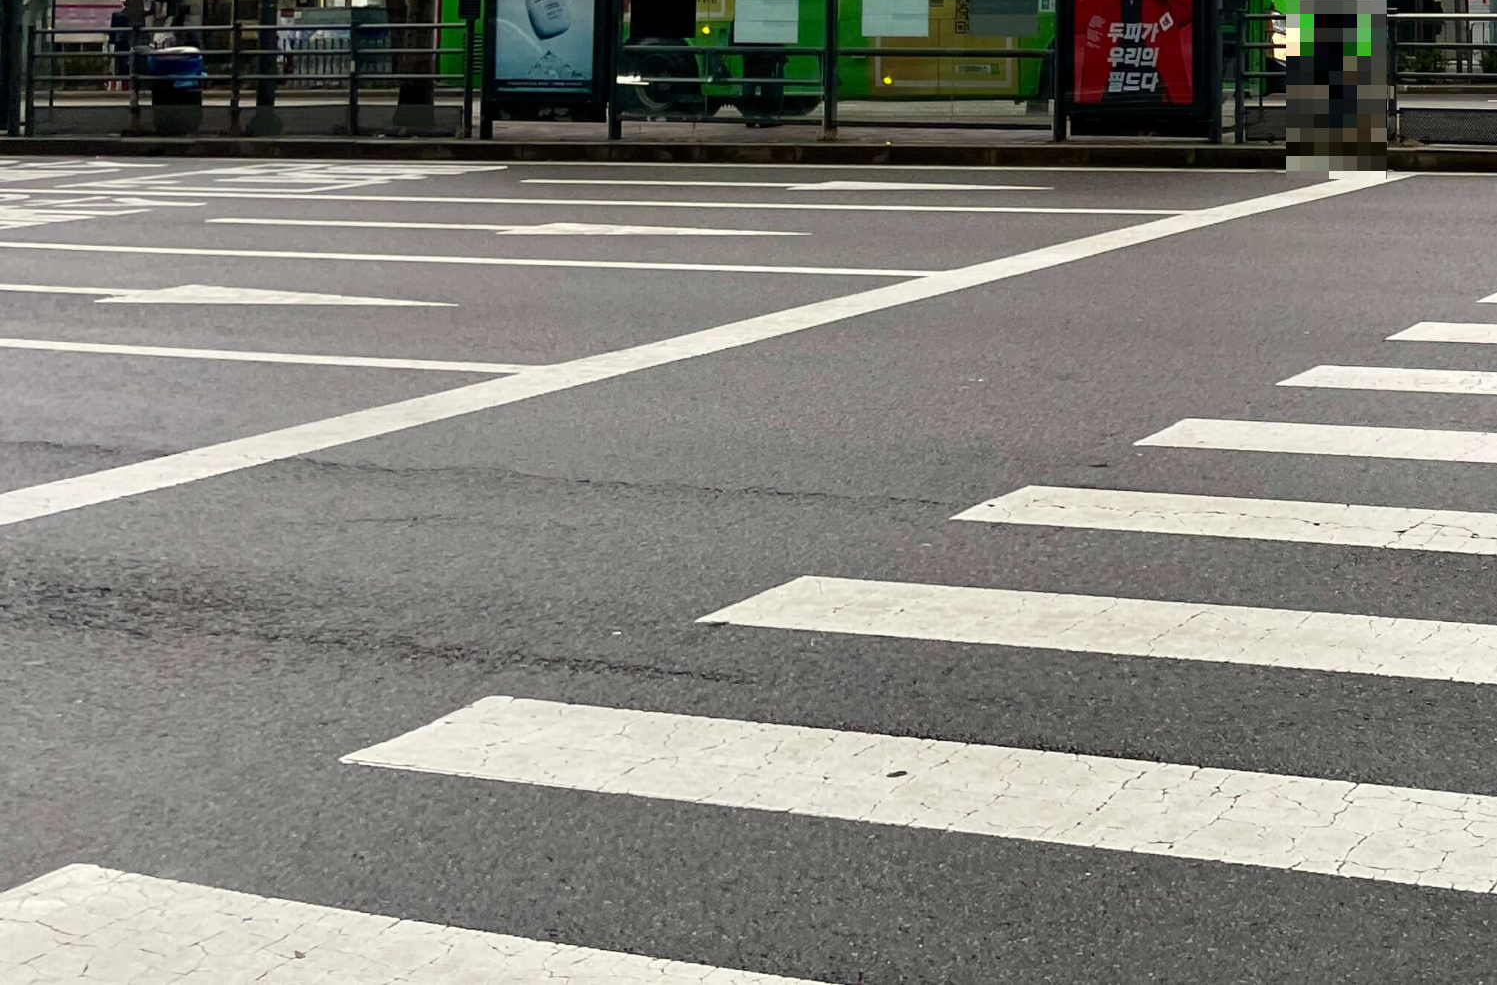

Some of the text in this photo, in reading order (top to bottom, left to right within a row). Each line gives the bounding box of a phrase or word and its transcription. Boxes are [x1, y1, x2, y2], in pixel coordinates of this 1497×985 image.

[1107, 22, 1159, 43] 두피가
[1107, 47, 1159, 68] 우리의
[1108, 72, 1159, 93] 필드다
